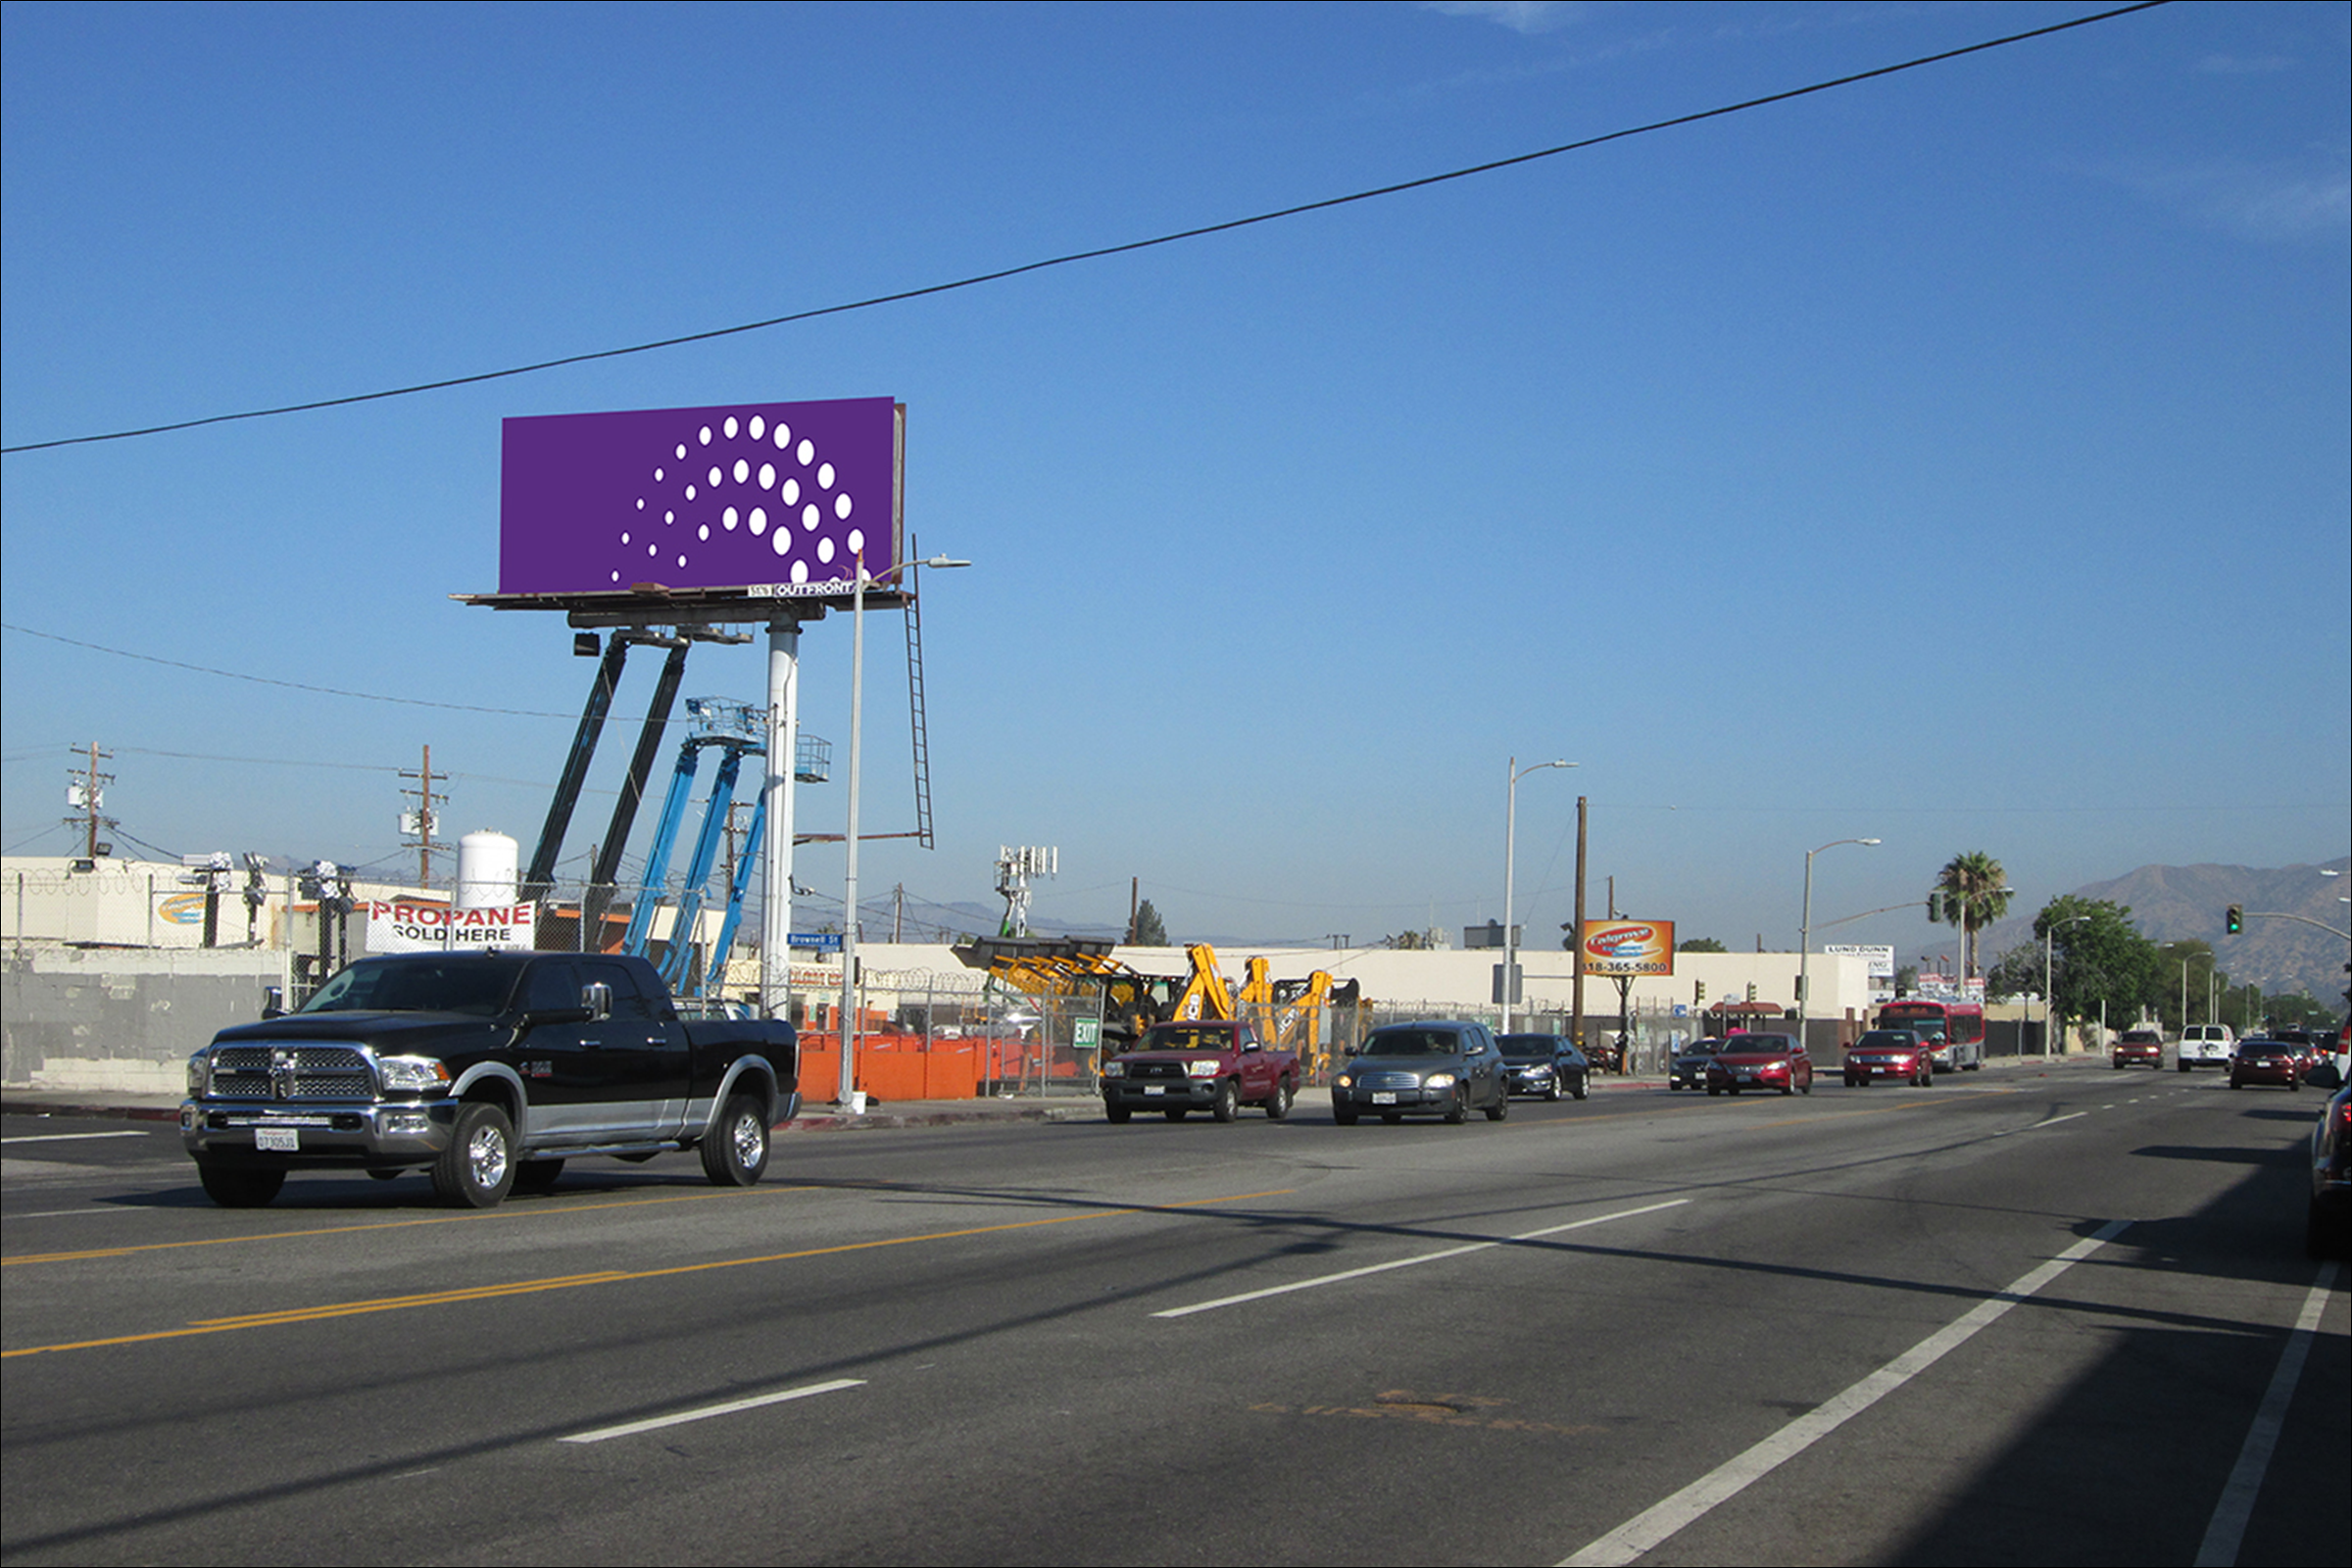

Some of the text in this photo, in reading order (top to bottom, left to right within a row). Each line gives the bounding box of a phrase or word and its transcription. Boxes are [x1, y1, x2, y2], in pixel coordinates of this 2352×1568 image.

[777, 582, 854, 596] OUTFRONT
[372, 901, 531, 926] PROPANE
[393, 924, 512, 942] SOLD HERE
[791, 935, 826, 944] Brownell
[1591, 927, 1649, 947] Calgrove
[1076, 1022, 1097, 1043] EXIT
